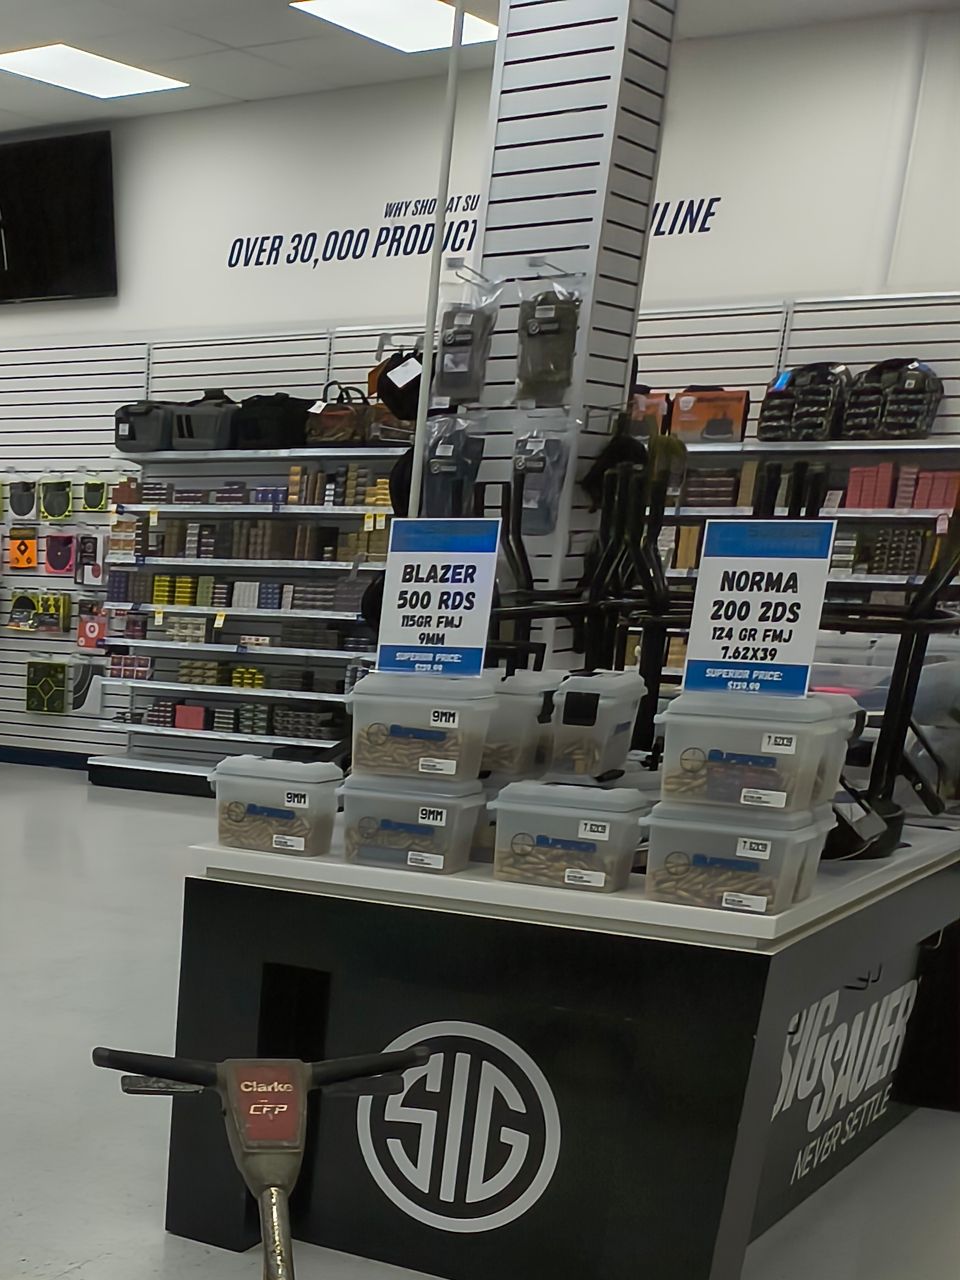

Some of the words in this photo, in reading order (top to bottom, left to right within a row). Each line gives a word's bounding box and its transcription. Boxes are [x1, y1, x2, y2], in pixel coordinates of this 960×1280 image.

[384, 200, 412, 218] WHY
[412, 198, 437, 216] SHO
[445, 196, 462, 213] AT
[228, 235, 283, 268] OVER
[286, 228, 370, 269] 30,000
[401, 564, 477, 584] BLAZER
[720, 570, 798, 593] NORMA
[397, 591, 431, 609] 500
[437, 591, 476, 610] RDS
[710, 600, 751, 621] 200
[758, 601, 801, 623] 2DS
[401, 615, 432, 628] 115GR
[436, 616, 463, 628] FMJ
[418, 632, 445, 645] 9MM
[711, 627, 734, 641] 124
[739, 628, 758, 642] GR
[762, 629, 793, 643] FMJ
[721, 646, 778, 661] 7.62X39
[705, 668, 750, 679] SUPERIOR
[432, 710, 456, 724] 9MM
[286, 792, 307, 804] 9MM
[420, 808, 443, 822] 9MM
[771, 989, 840, 1122] SIG
[807, 979, 918, 1132] SAUER
[240, 1081, 294, 1092] Clarke
[249, 1104, 288, 1115] CFP
[384, 1052, 530, 1203] SIG
[790, 1121, 842, 1185] NEVER
[841, 1082, 893, 1144] SETTLE
